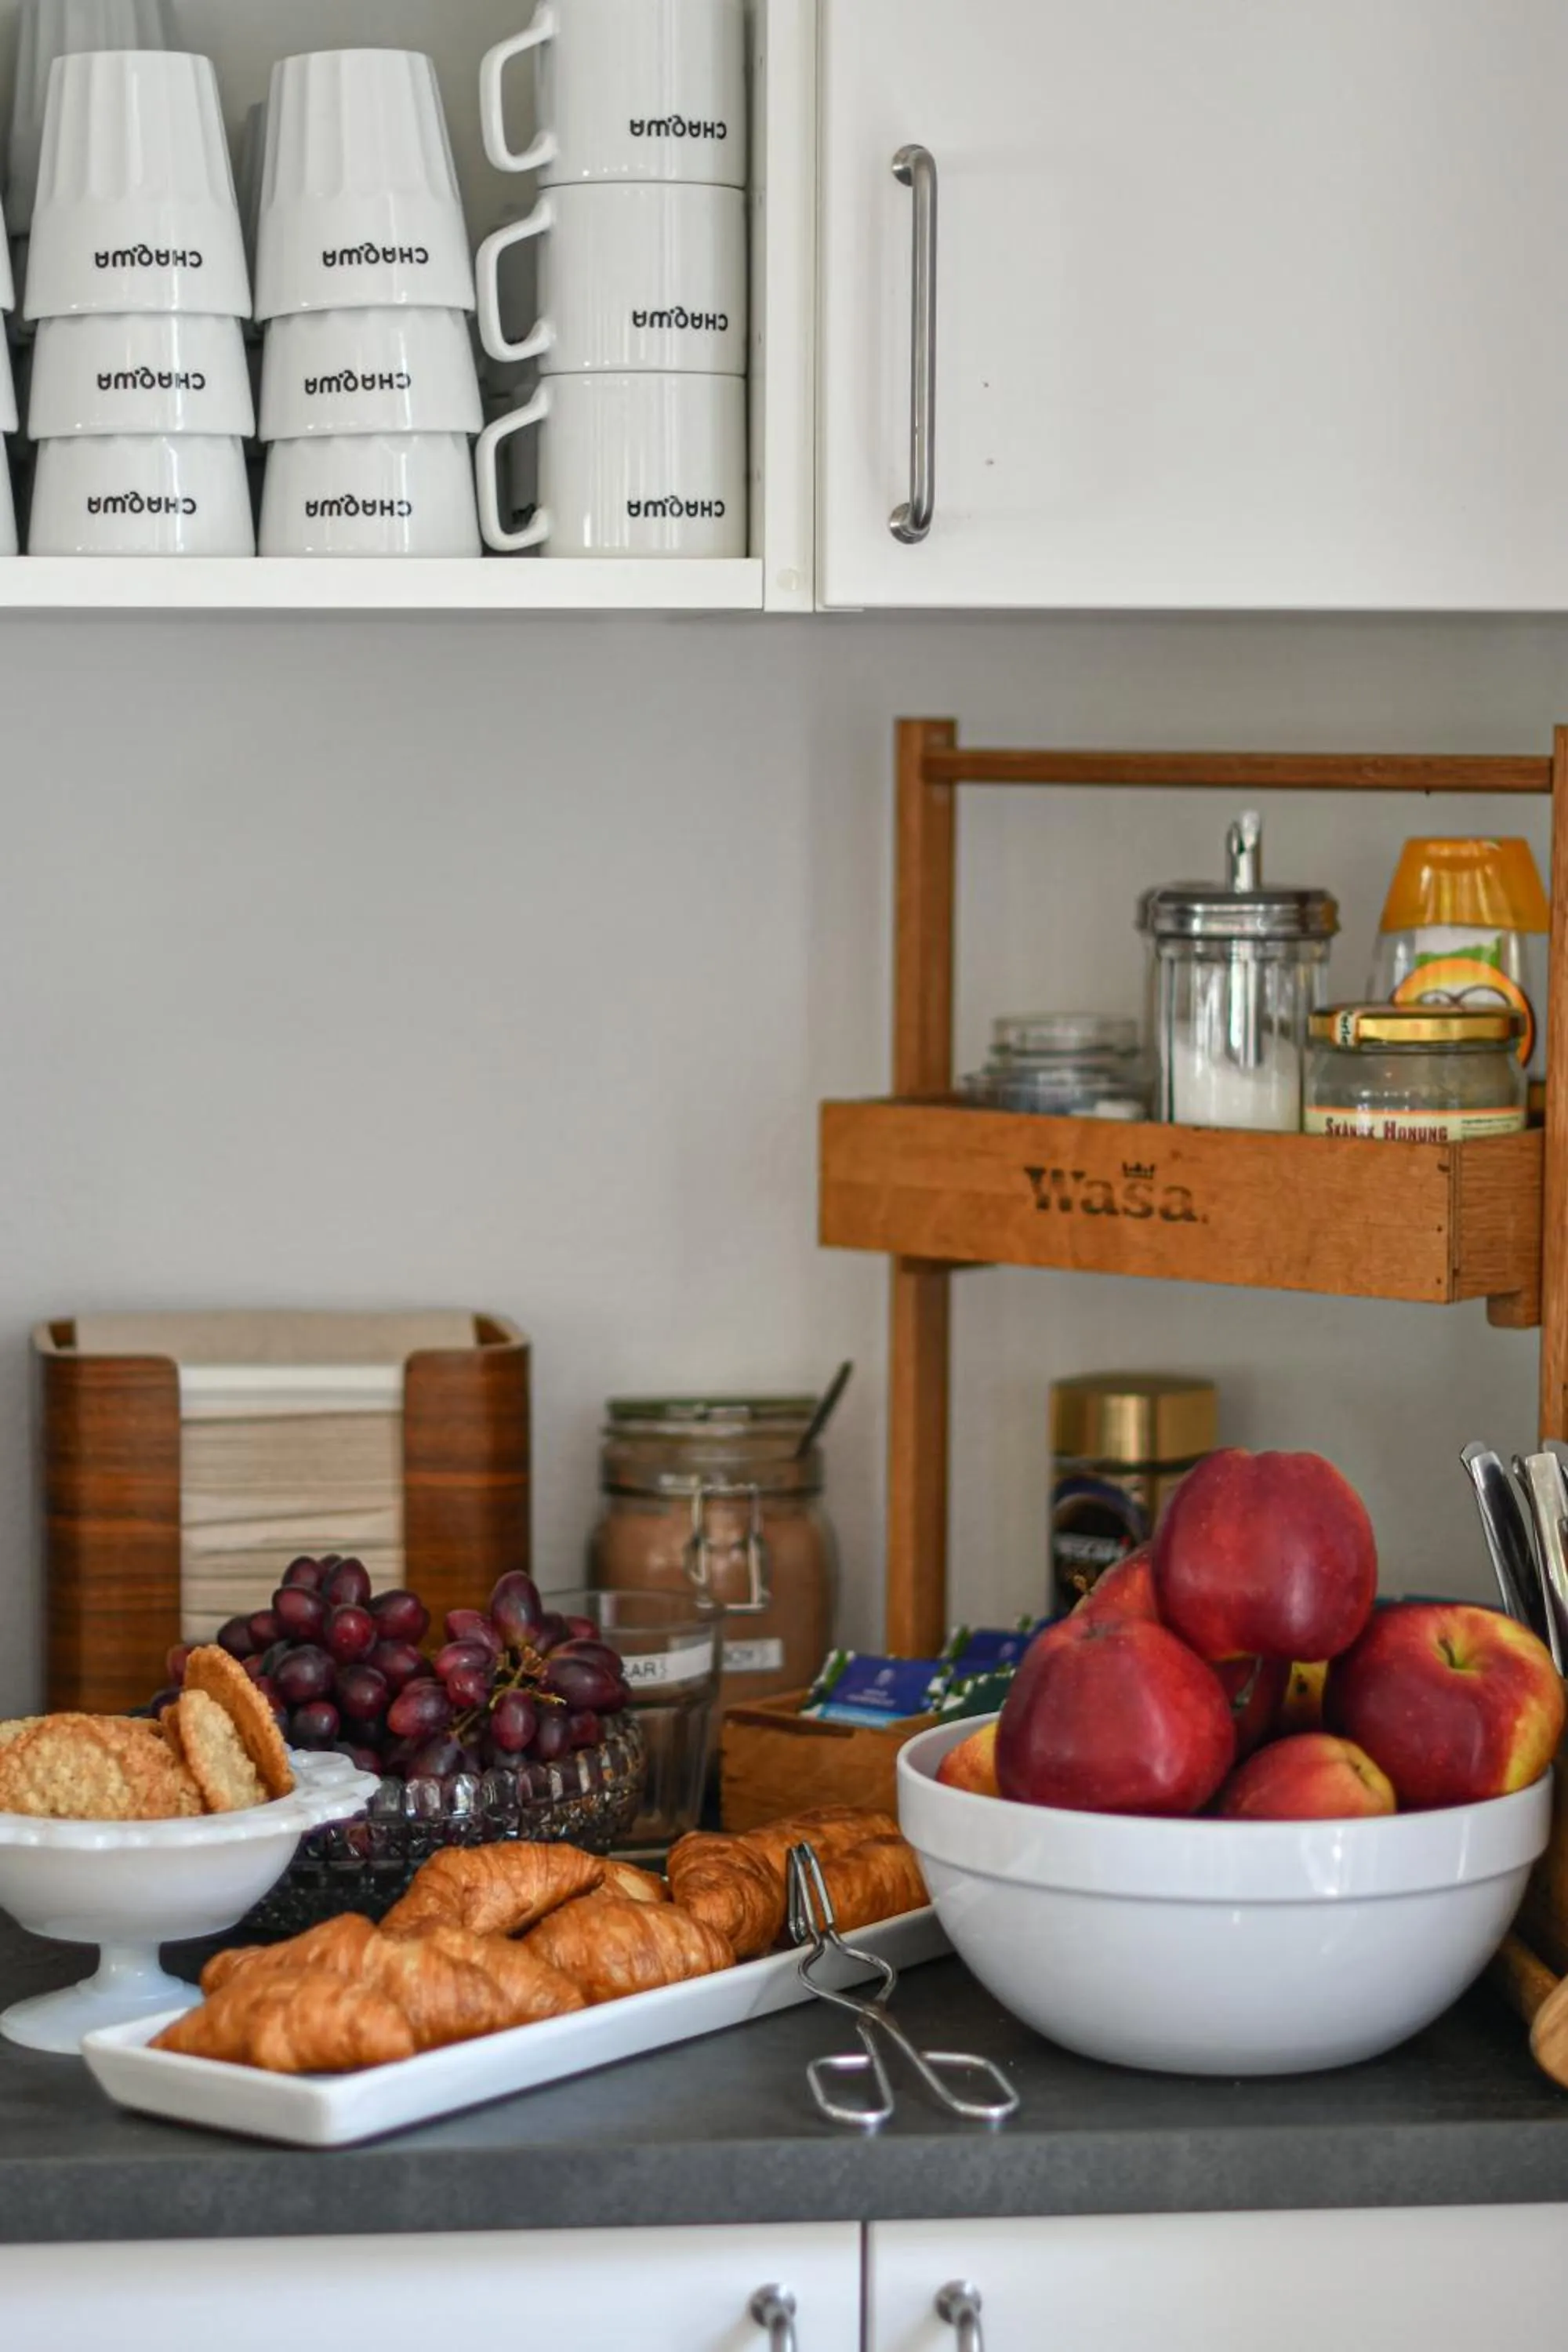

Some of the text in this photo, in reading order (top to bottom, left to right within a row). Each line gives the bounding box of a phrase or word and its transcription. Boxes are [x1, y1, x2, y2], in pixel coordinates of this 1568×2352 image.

[630, 115, 727, 140] CHAQWA
[95, 245, 202, 268] CHAQWA
[323, 243, 428, 267] CHAQWA
[633, 307, 728, 332] CHAQWA
[98, 367, 205, 390] CHAQWA
[305, 370, 411, 394] CHAQWA
[88, 492, 196, 514] CHAQWA
[306, 495, 412, 517] CHAQWA
[627, 495, 725, 517] CHAQWA
[1383, 1120, 1449, 1142] HONUNG
